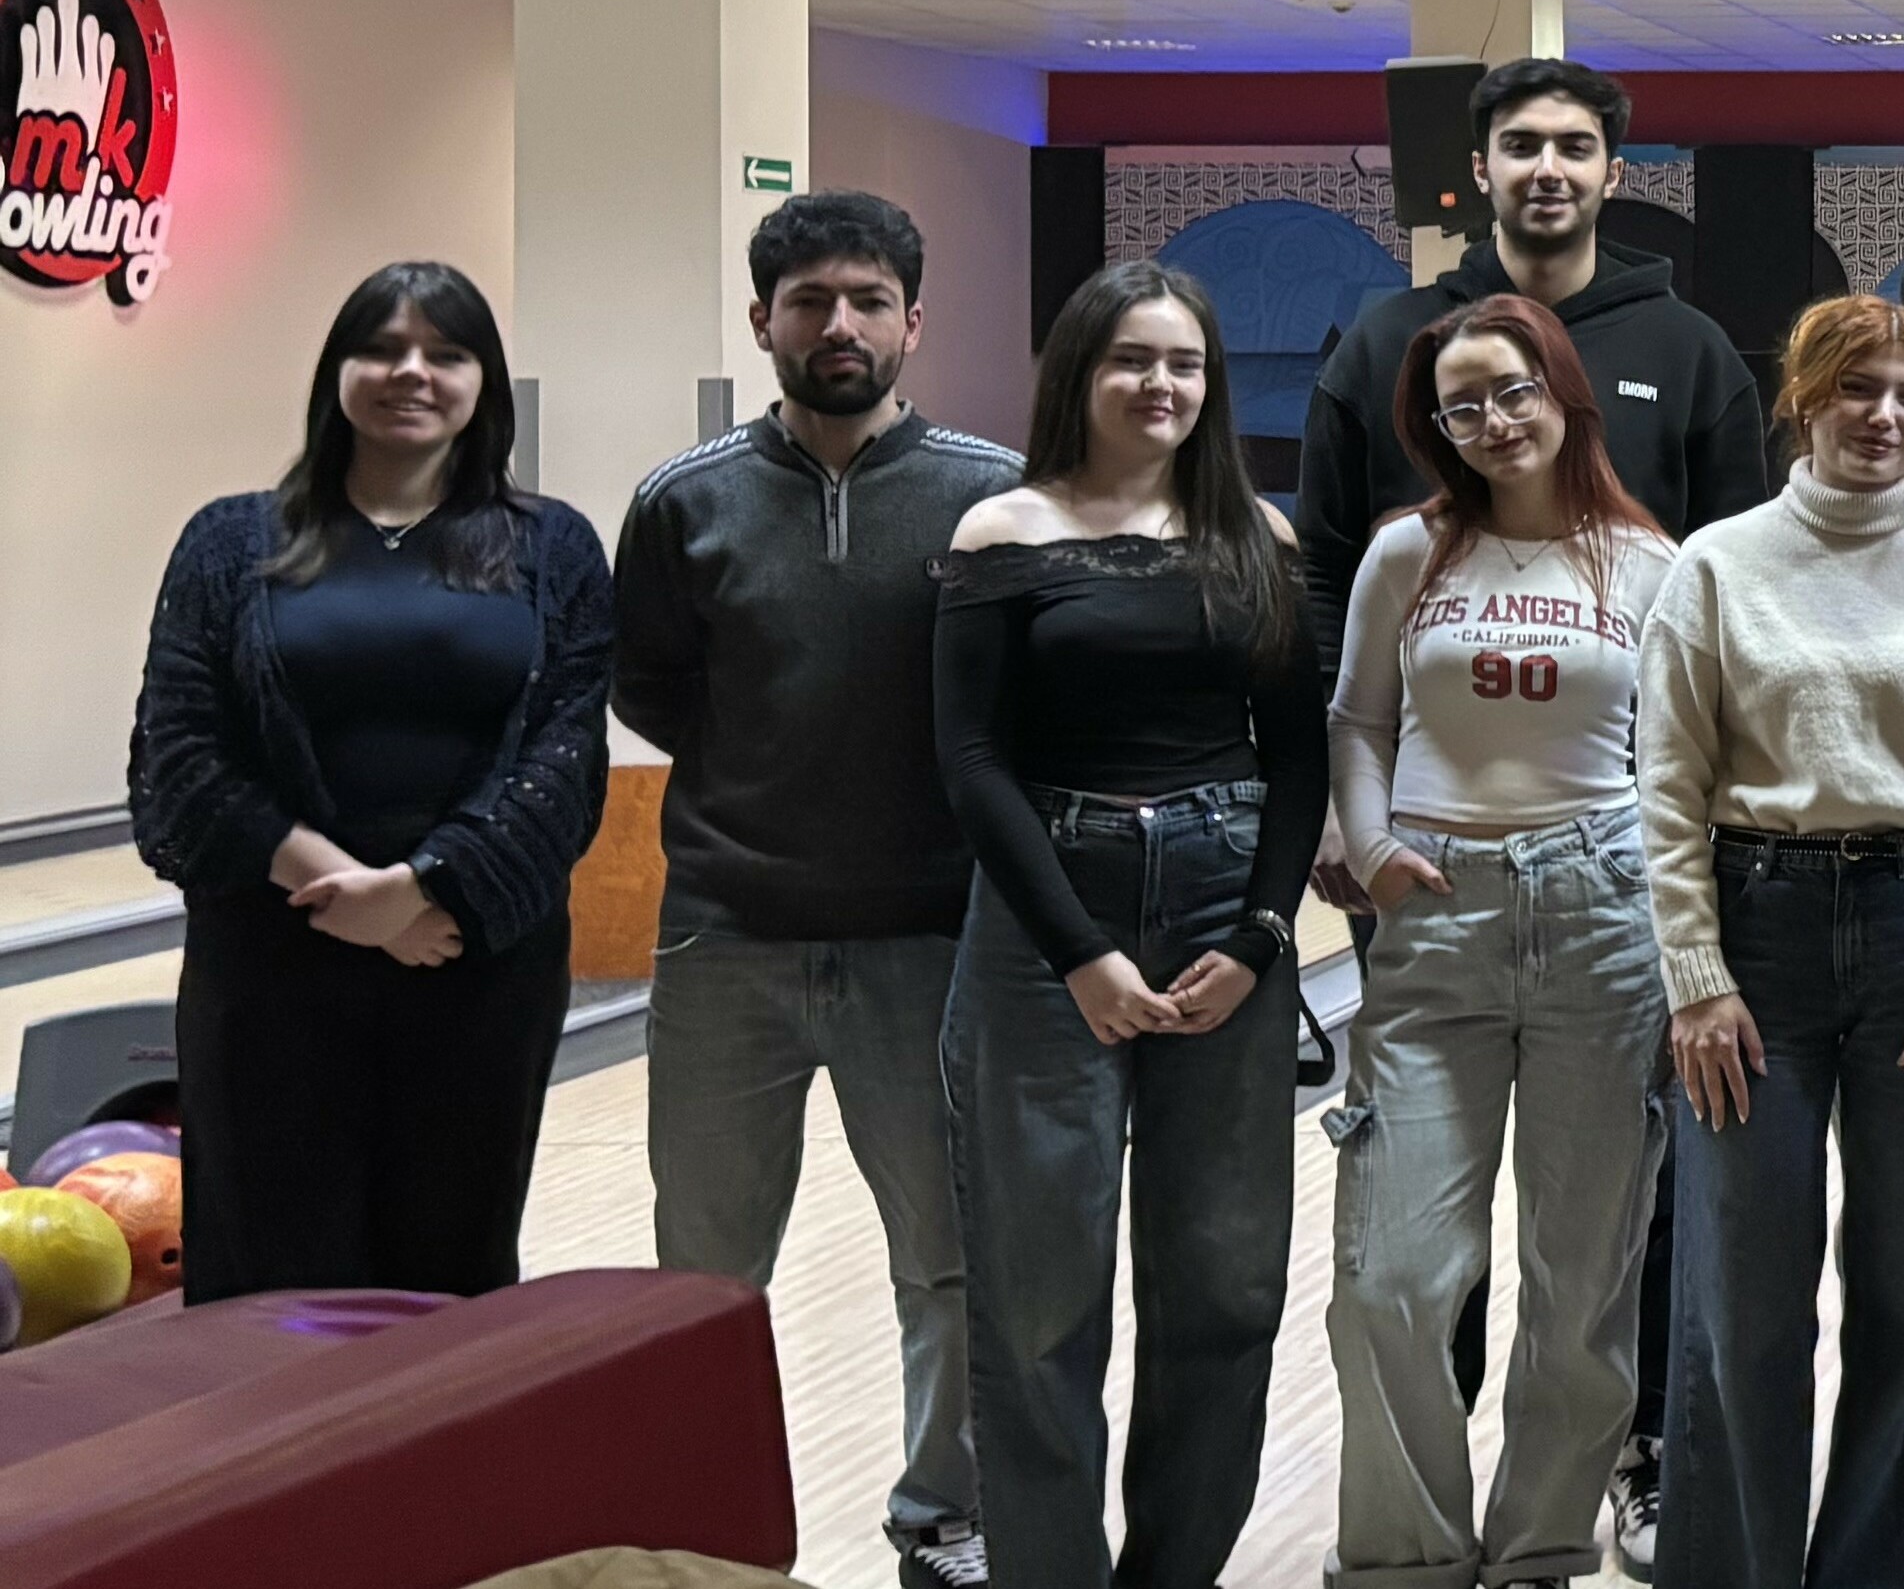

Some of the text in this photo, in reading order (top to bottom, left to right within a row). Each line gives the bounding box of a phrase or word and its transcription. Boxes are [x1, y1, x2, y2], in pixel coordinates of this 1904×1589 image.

[10, 67, 136, 191] mk
[0, 156, 172, 302] owling
[1413, 594, 1629, 650] LOS ANGELES
[1461, 630, 1570, 648] CALIFORNIA
[1471, 651, 1559, 702] 90
